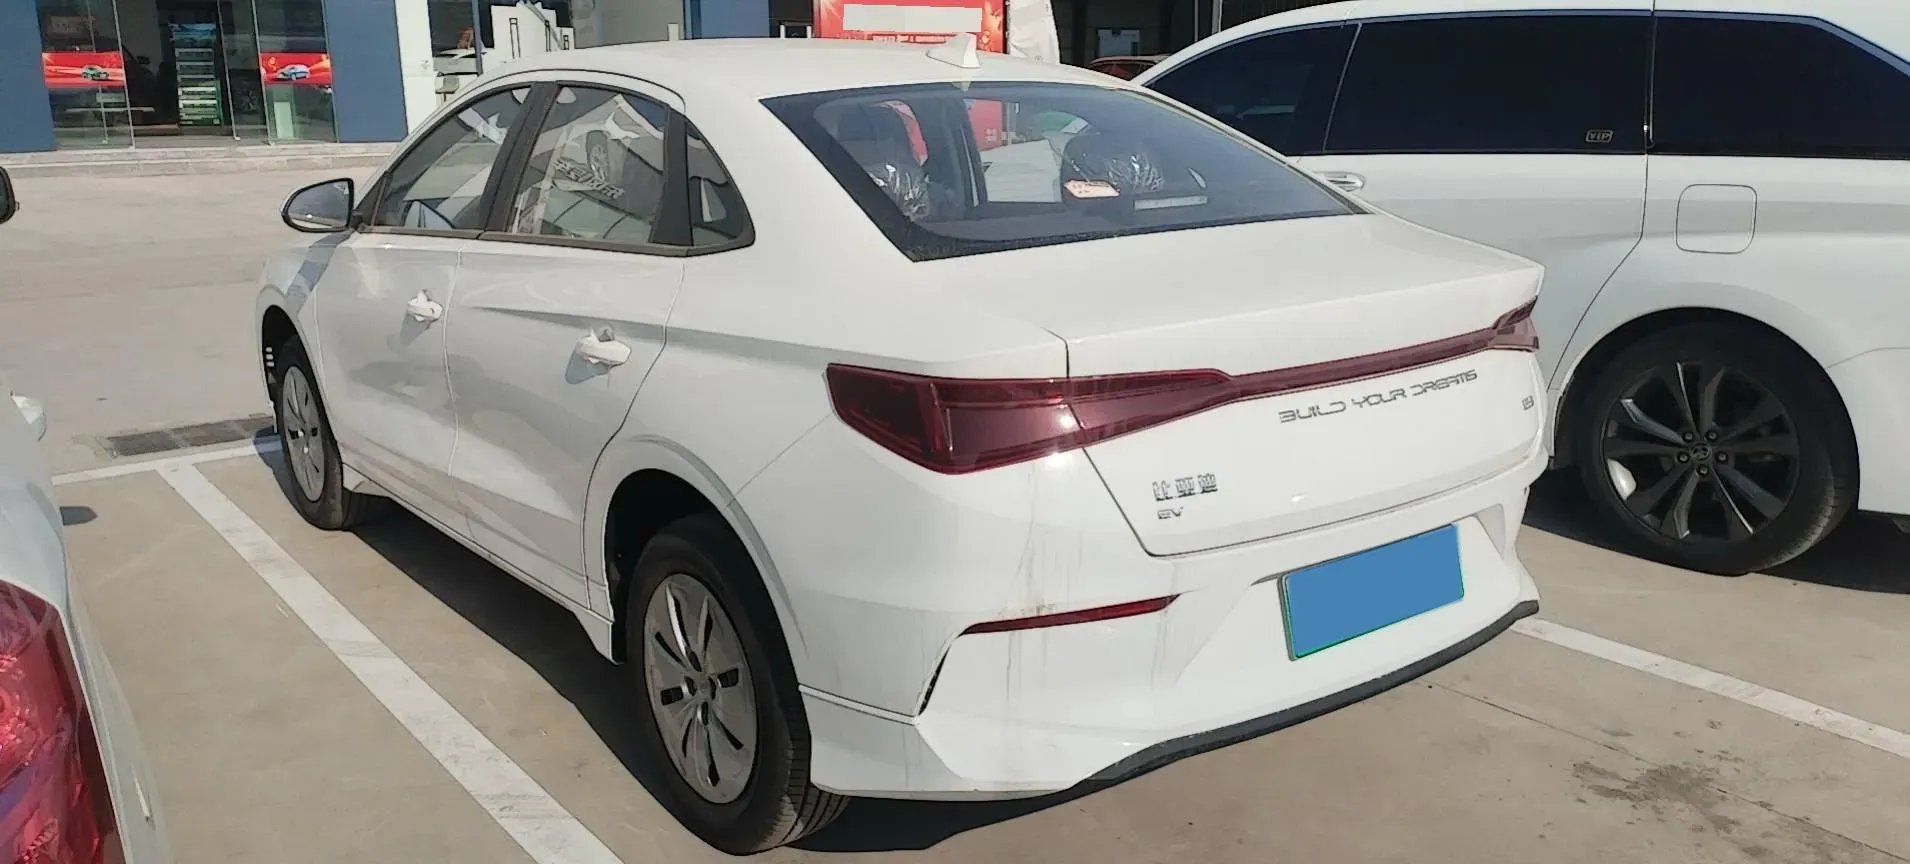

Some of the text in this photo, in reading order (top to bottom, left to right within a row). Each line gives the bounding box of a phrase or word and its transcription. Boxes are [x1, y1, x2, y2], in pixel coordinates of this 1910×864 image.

[1278, 369, 1478, 423] BUILD YOUR DREAMS
[1152, 473, 1218, 501] 比亚迪
[1157, 506, 1183, 520] EV
